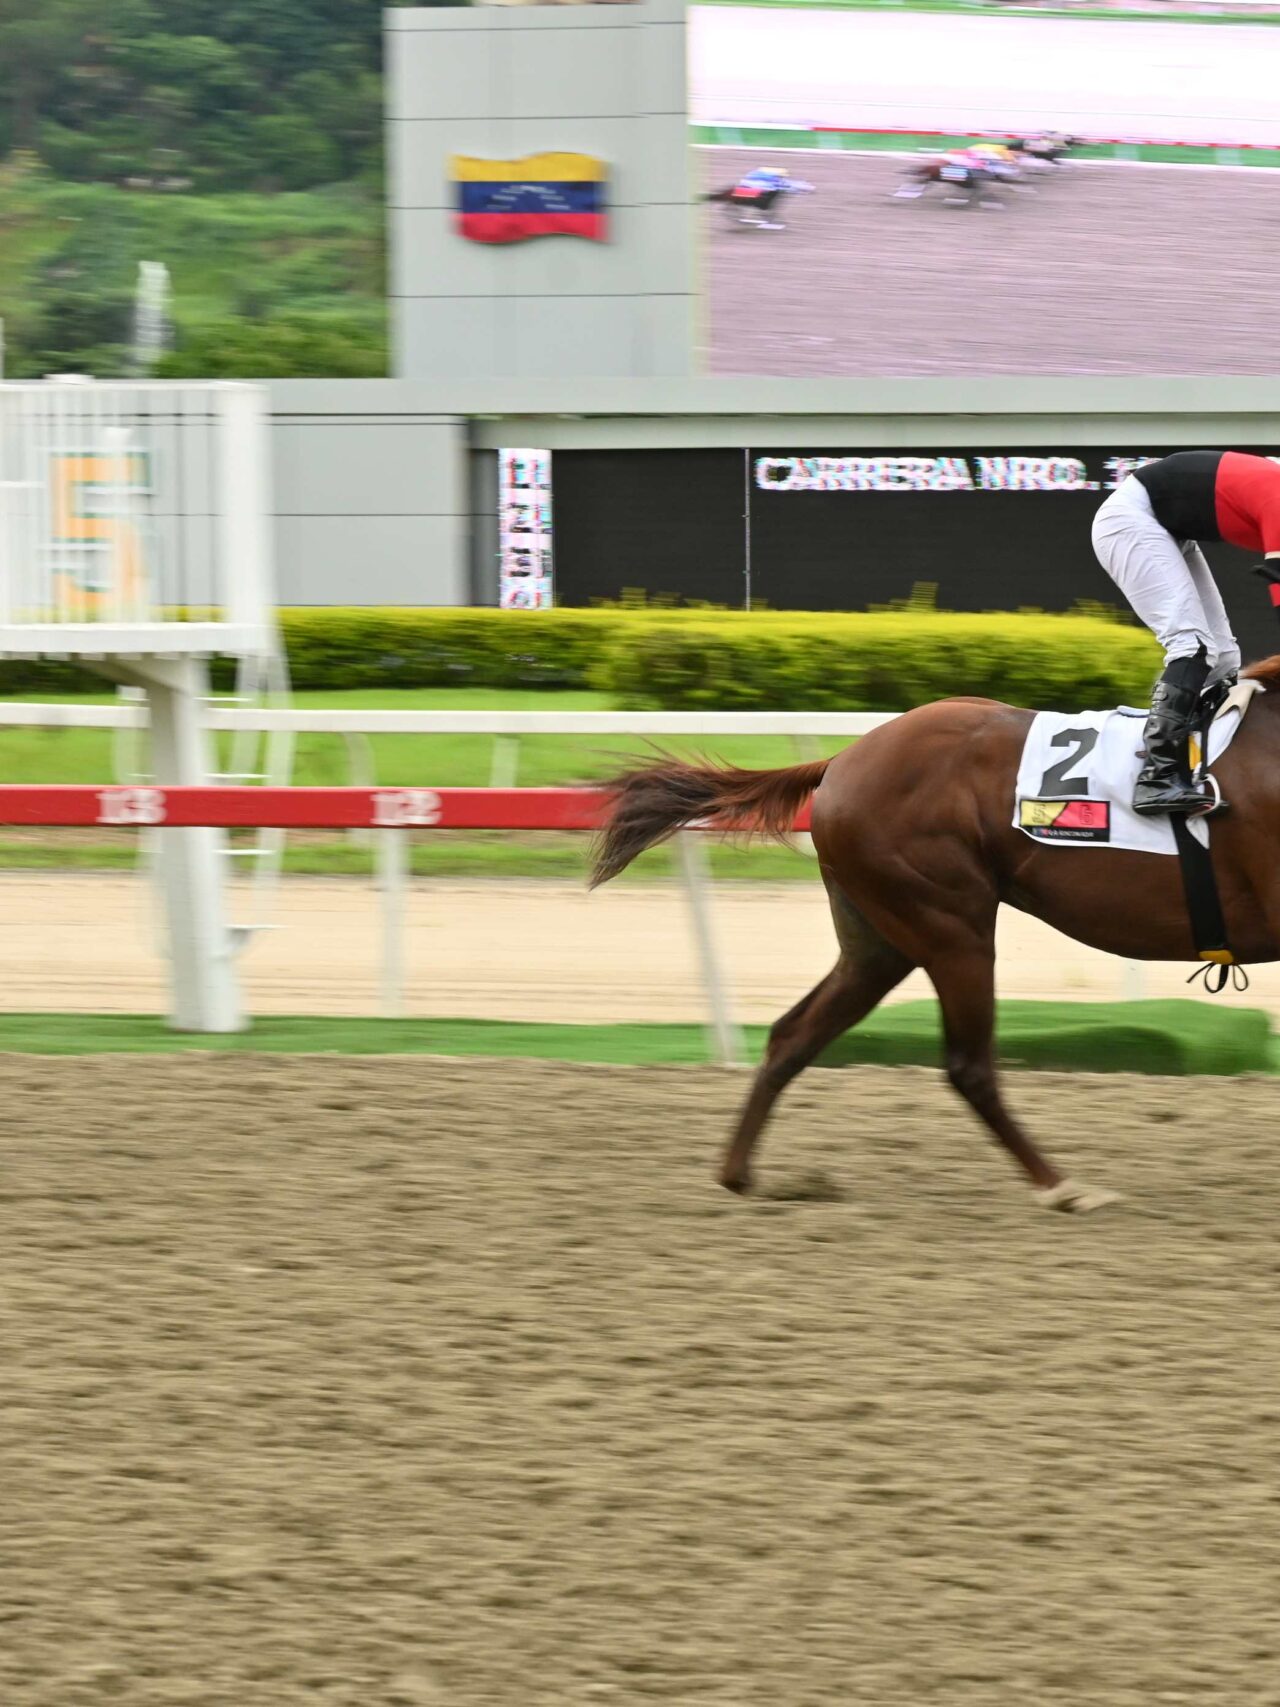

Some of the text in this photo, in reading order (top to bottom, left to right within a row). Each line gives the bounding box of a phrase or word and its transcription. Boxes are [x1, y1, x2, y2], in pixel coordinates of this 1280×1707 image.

[755, 457, 972, 490] CARRERA
[50, 450, 153, 622] 5
[1038, 727, 1100, 797] 2
[97, 788, 167, 824] 13
[370, 790, 443, 825] 12
